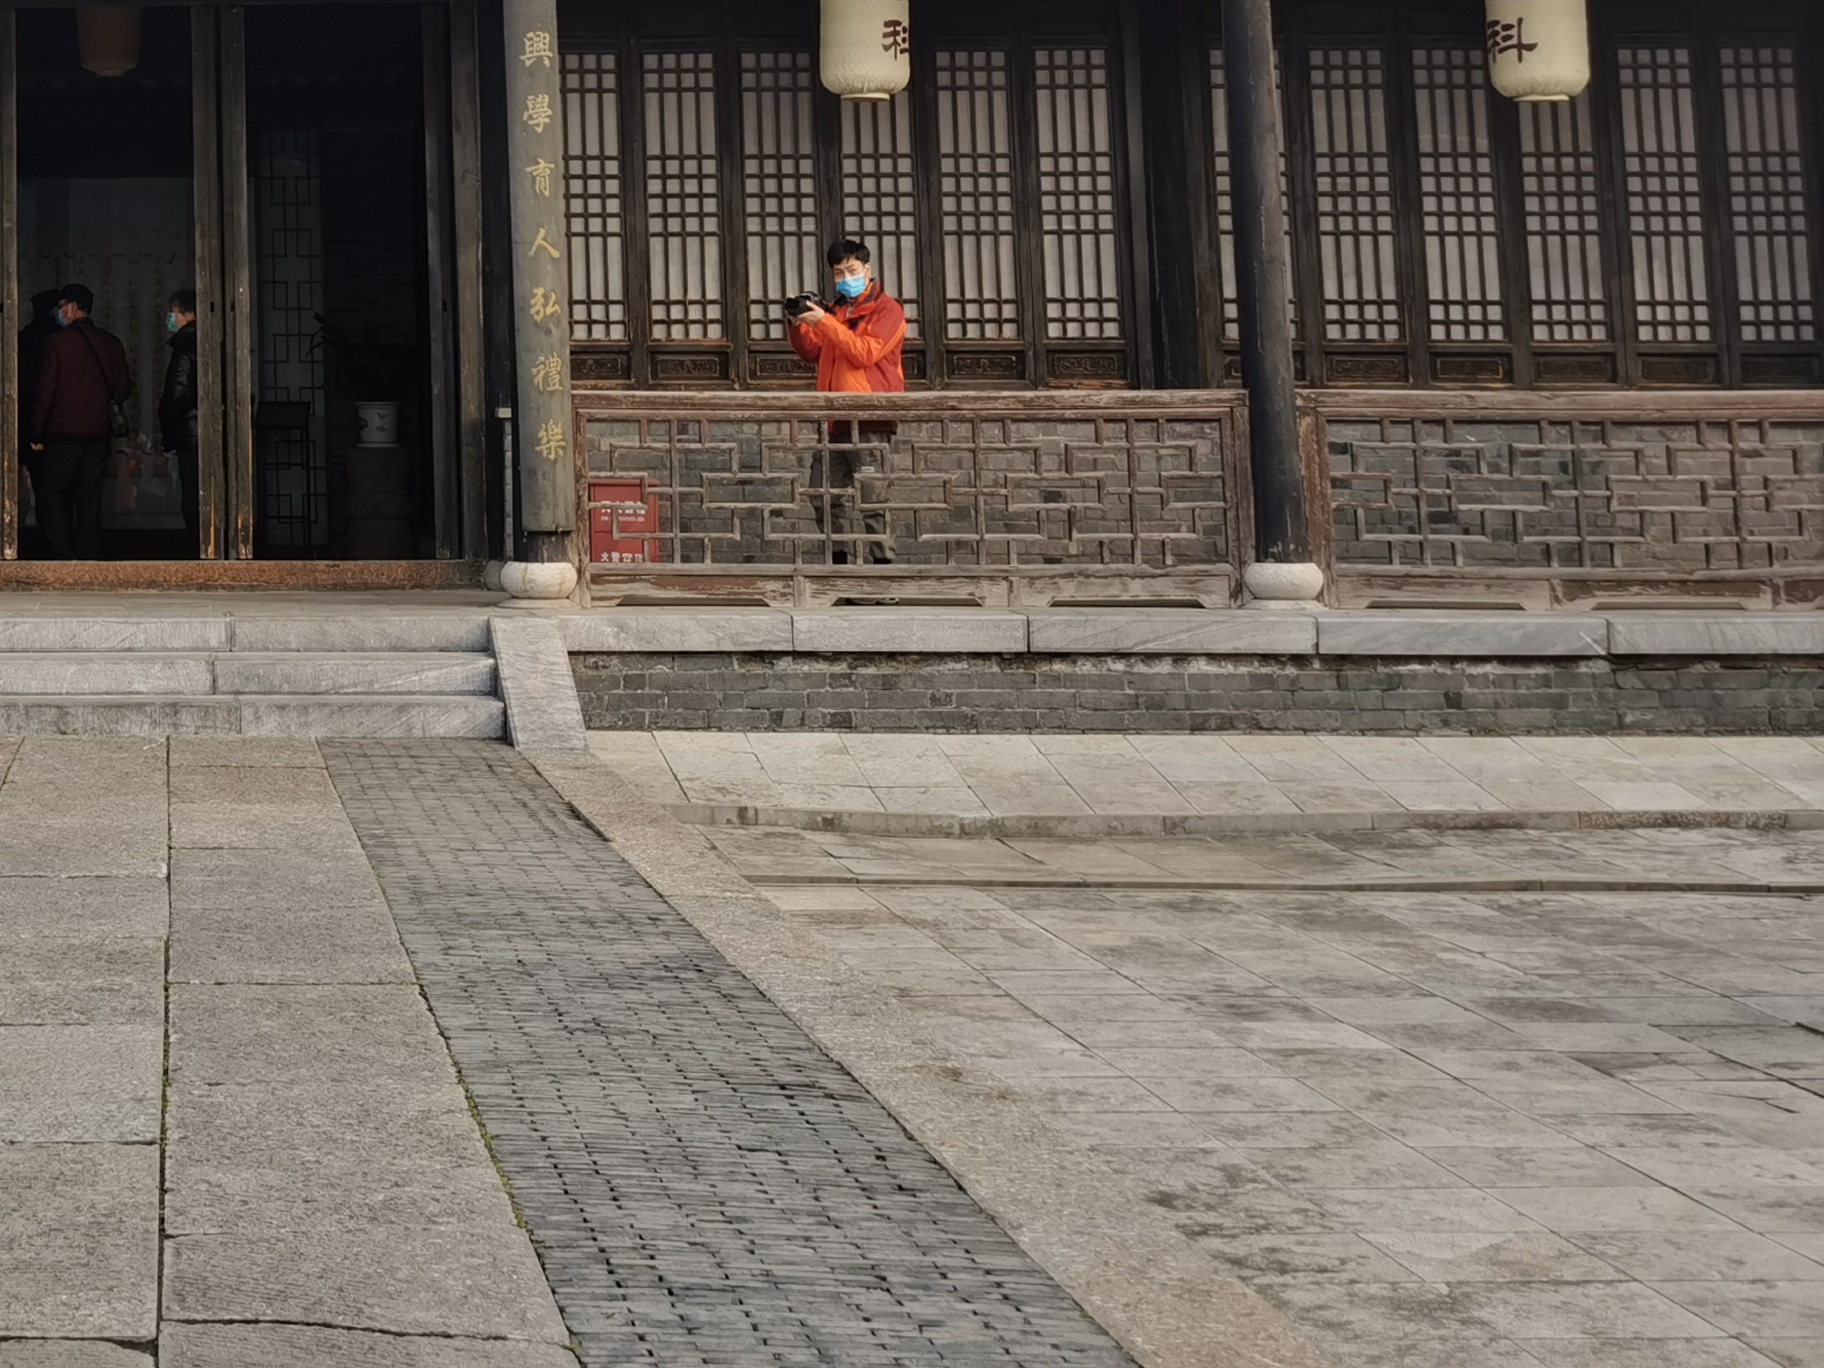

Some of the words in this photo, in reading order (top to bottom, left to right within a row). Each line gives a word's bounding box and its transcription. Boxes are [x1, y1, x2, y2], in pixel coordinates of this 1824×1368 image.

[519, 31, 567, 461] 興學育人弘禮樂
